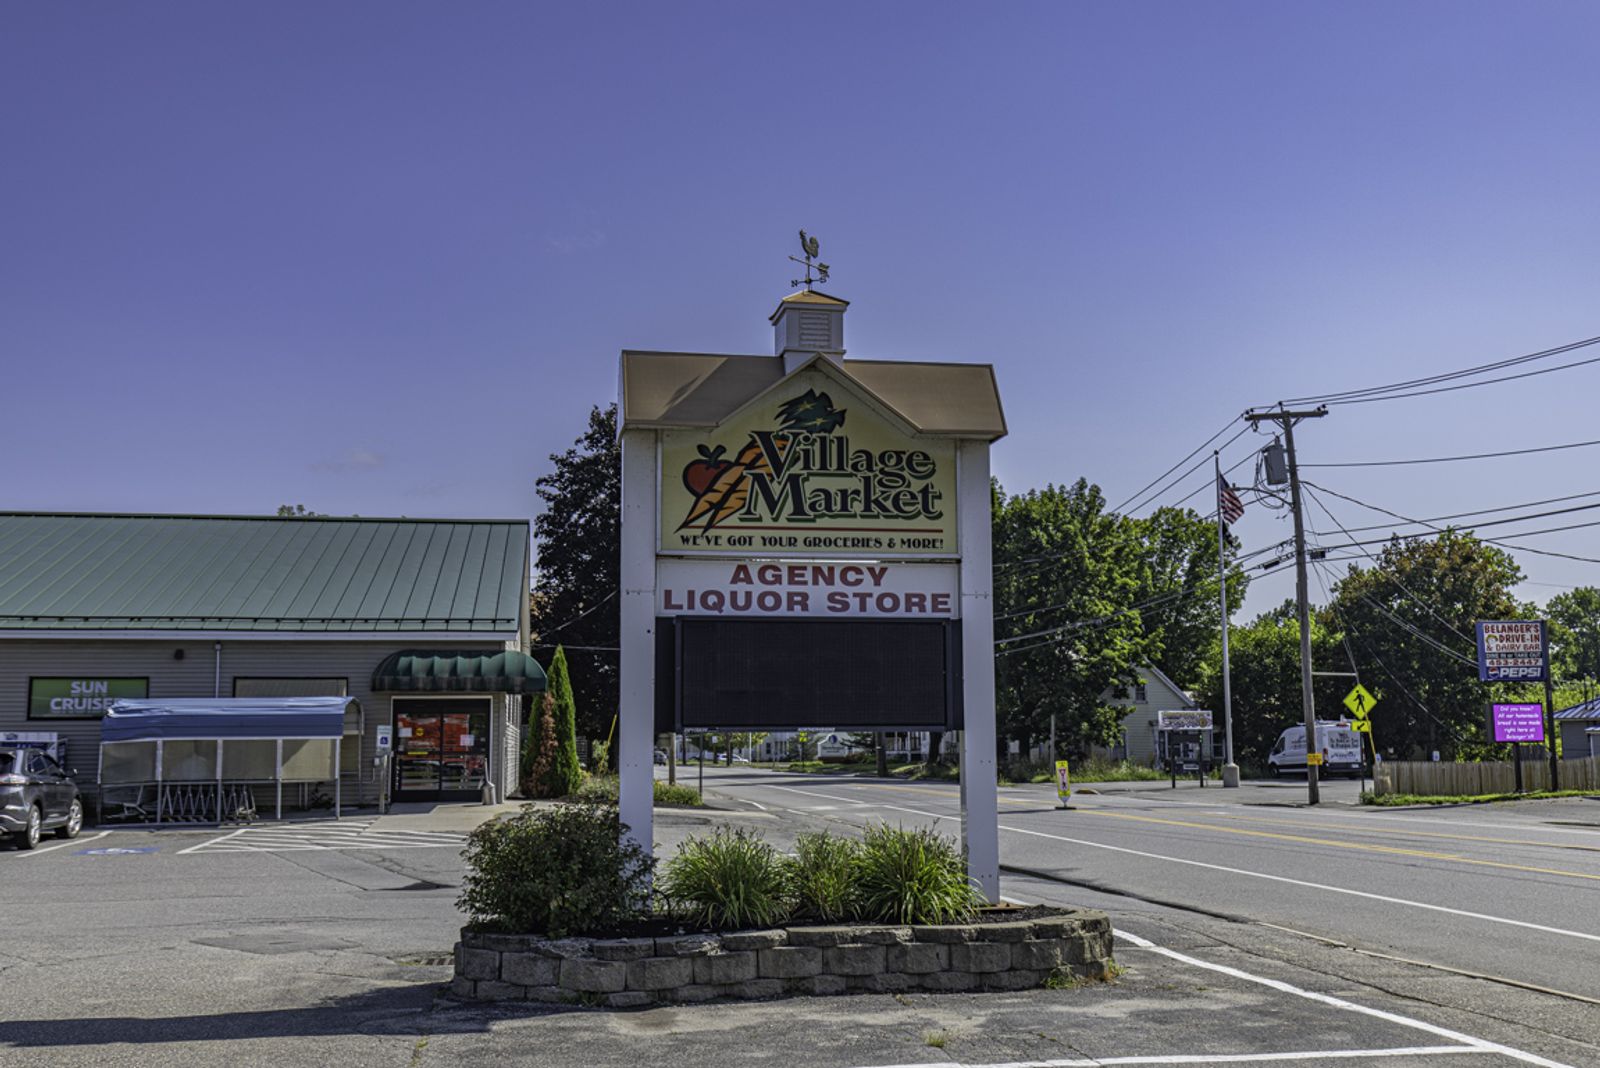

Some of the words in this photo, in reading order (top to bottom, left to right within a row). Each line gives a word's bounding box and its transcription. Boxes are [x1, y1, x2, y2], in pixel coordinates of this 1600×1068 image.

[750, 430, 935, 488] Village
[739, 471, 943, 522] Market
[680, 535, 722, 546] WE'VE
[727, 536, 755, 547] GOT
[761, 536, 798, 547] YOUR
[803, 537, 883, 549] GROCERIES
[888, 538, 896, 549] &
[901, 538, 944, 549] MORE!
[729, 564, 889, 586] AGENCY
[663, 589, 810, 613] LIQUOR
[827, 592, 952, 613] STORE
[1484, 623, 1540, 634] BELANGER'S
[1498, 634, 1540, 643] DRIVE-IN
[1496, 644, 1520, 652] DAIRY
[1499, 668, 1541, 677] PEPSI
[70, 681, 108, 694] SUN
[50, 697, 117, 711] CRUISE
